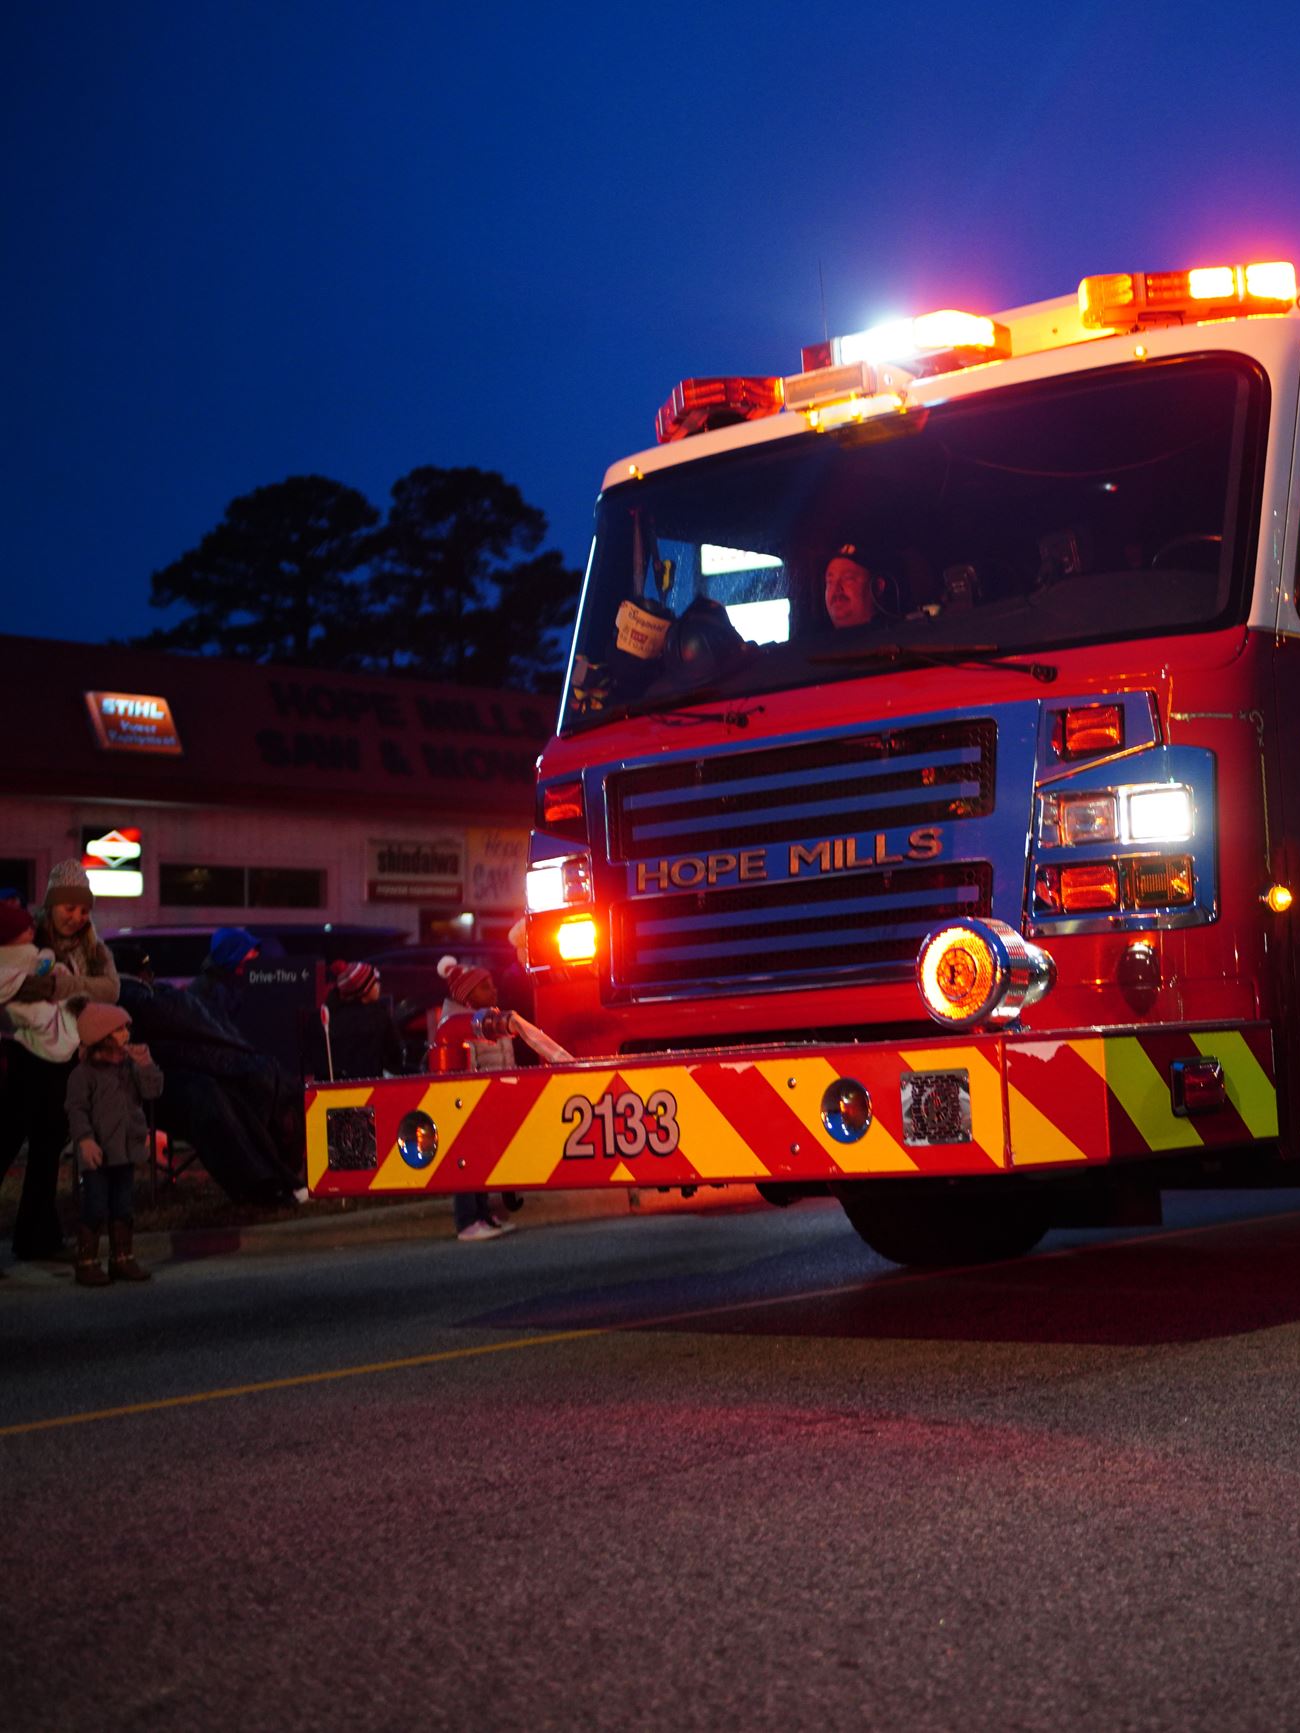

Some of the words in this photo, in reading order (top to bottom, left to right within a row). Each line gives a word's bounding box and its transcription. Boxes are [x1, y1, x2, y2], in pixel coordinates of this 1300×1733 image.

[101, 698, 165, 720] STIHL
[636, 848, 768, 892] HOPE
[788, 826, 945, 876] MILLS
[249, 968, 297, 984] Drive-Thru
[562, 1089, 680, 1159] 2133
